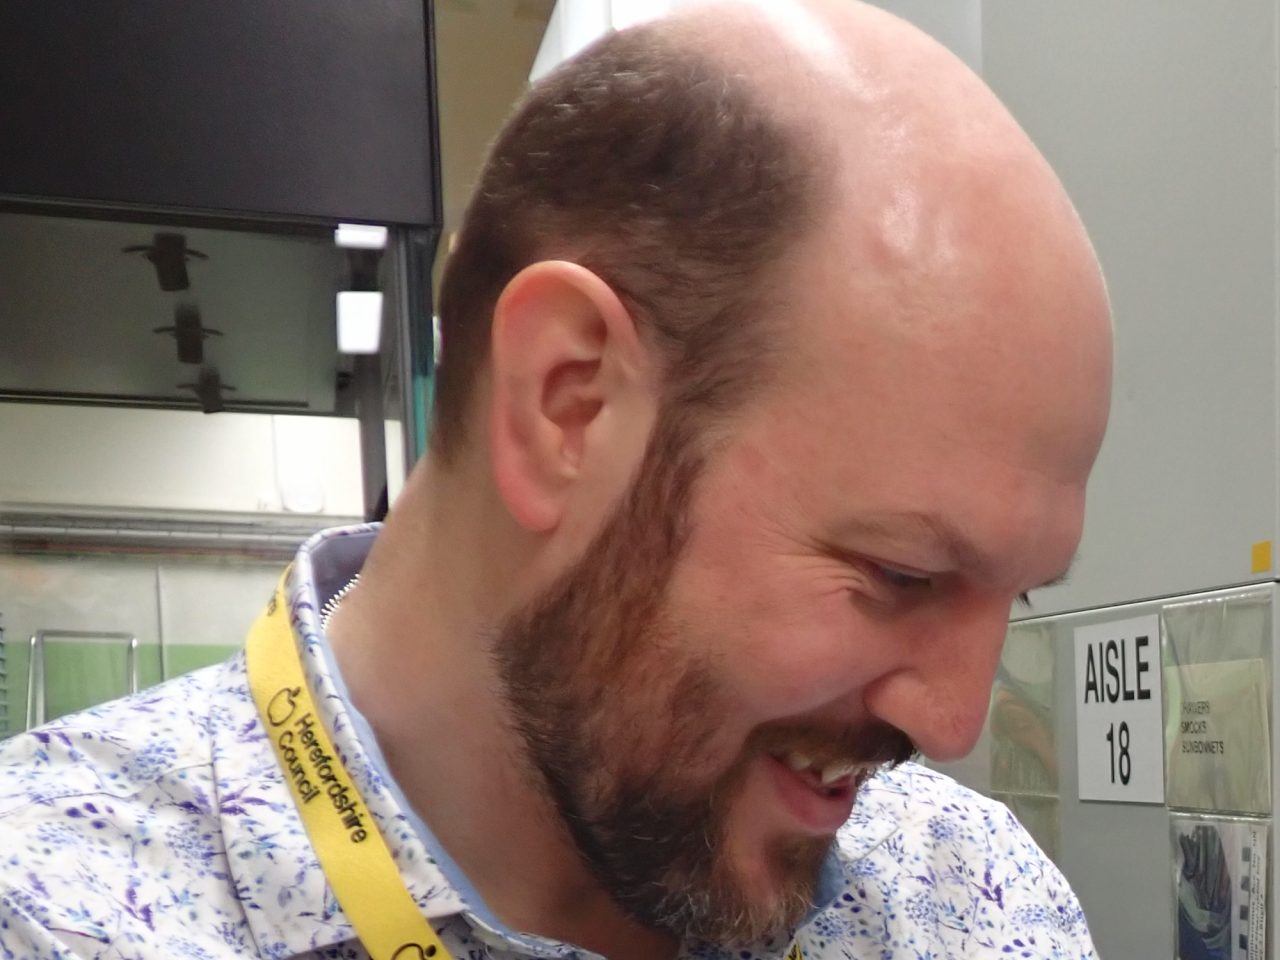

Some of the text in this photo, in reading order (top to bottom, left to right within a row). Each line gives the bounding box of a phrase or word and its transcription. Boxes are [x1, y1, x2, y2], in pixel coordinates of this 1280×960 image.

[1084, 635, 1151, 703] AISLE
[278, 730, 321, 804] Council
[294, 712, 367, 844] Herefordshire
[1106, 721, 1131, 786] 18
